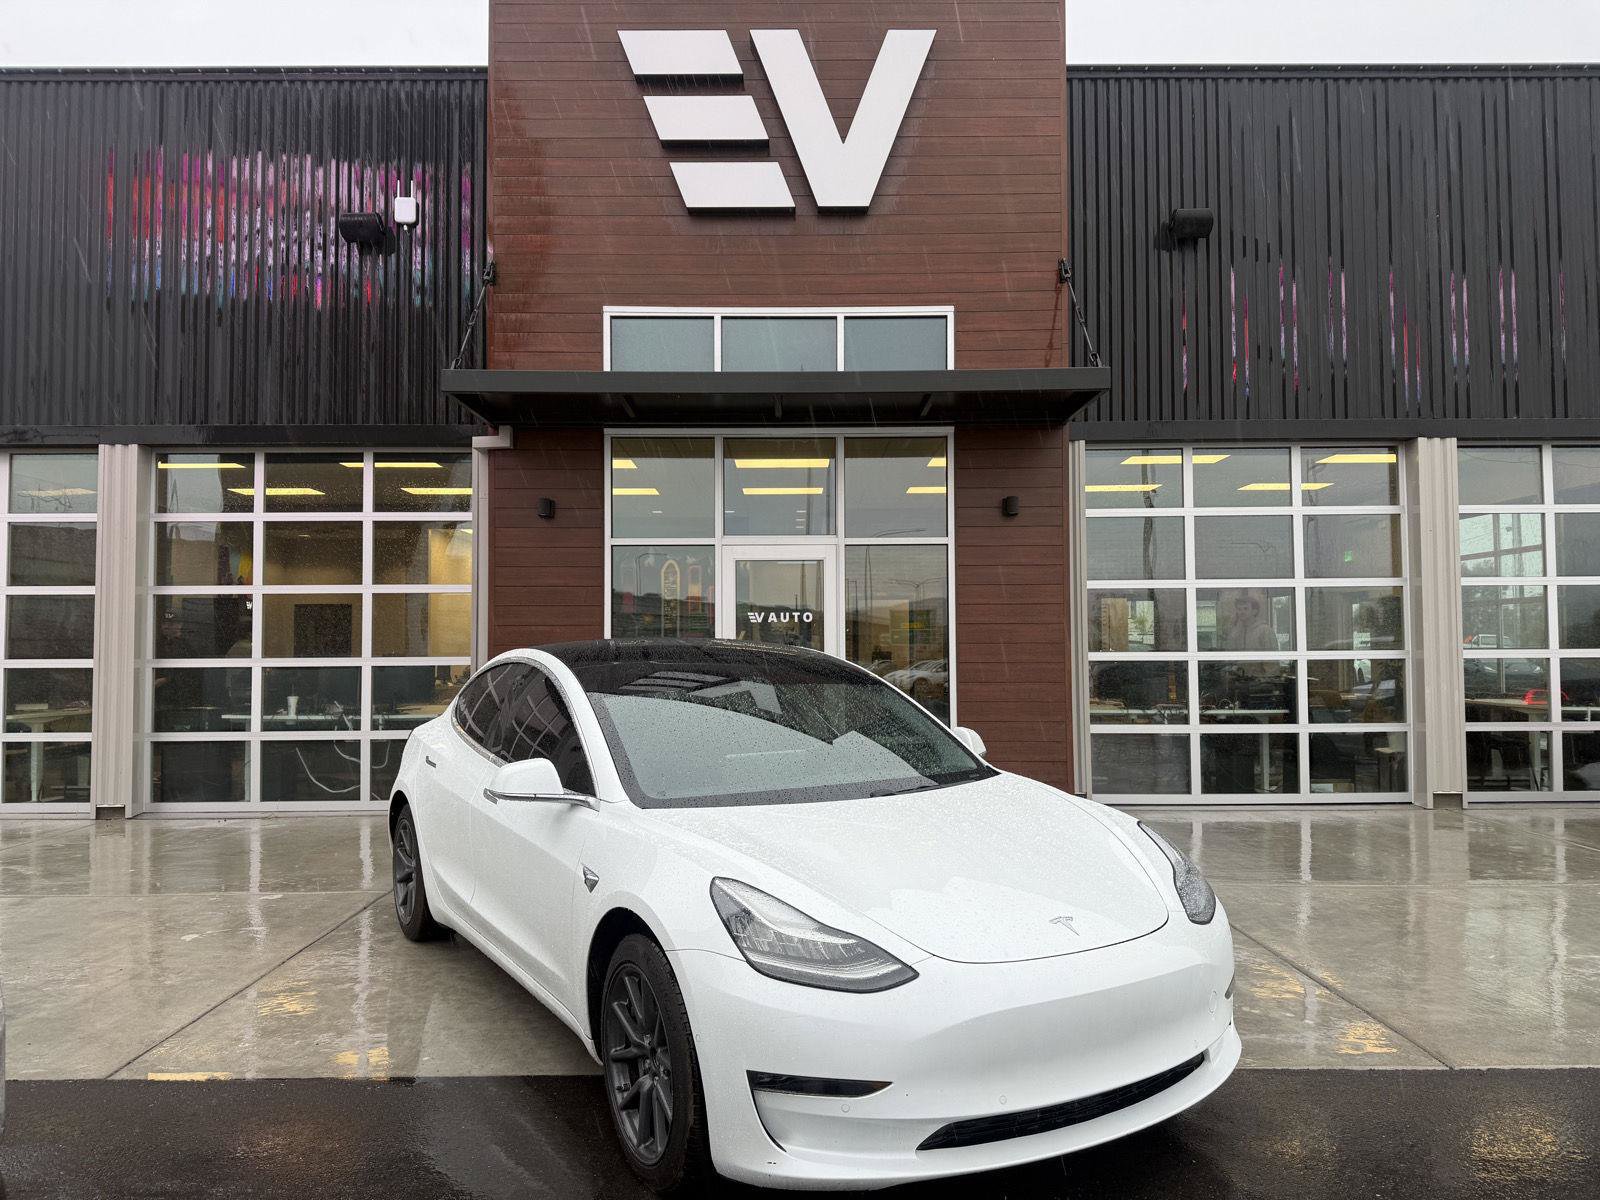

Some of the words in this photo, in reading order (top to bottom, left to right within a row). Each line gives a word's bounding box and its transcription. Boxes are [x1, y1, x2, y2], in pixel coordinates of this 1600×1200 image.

[616, 28, 938, 212] EV
[747, 612, 765, 623] EV
[767, 611, 813, 623] AUTO
